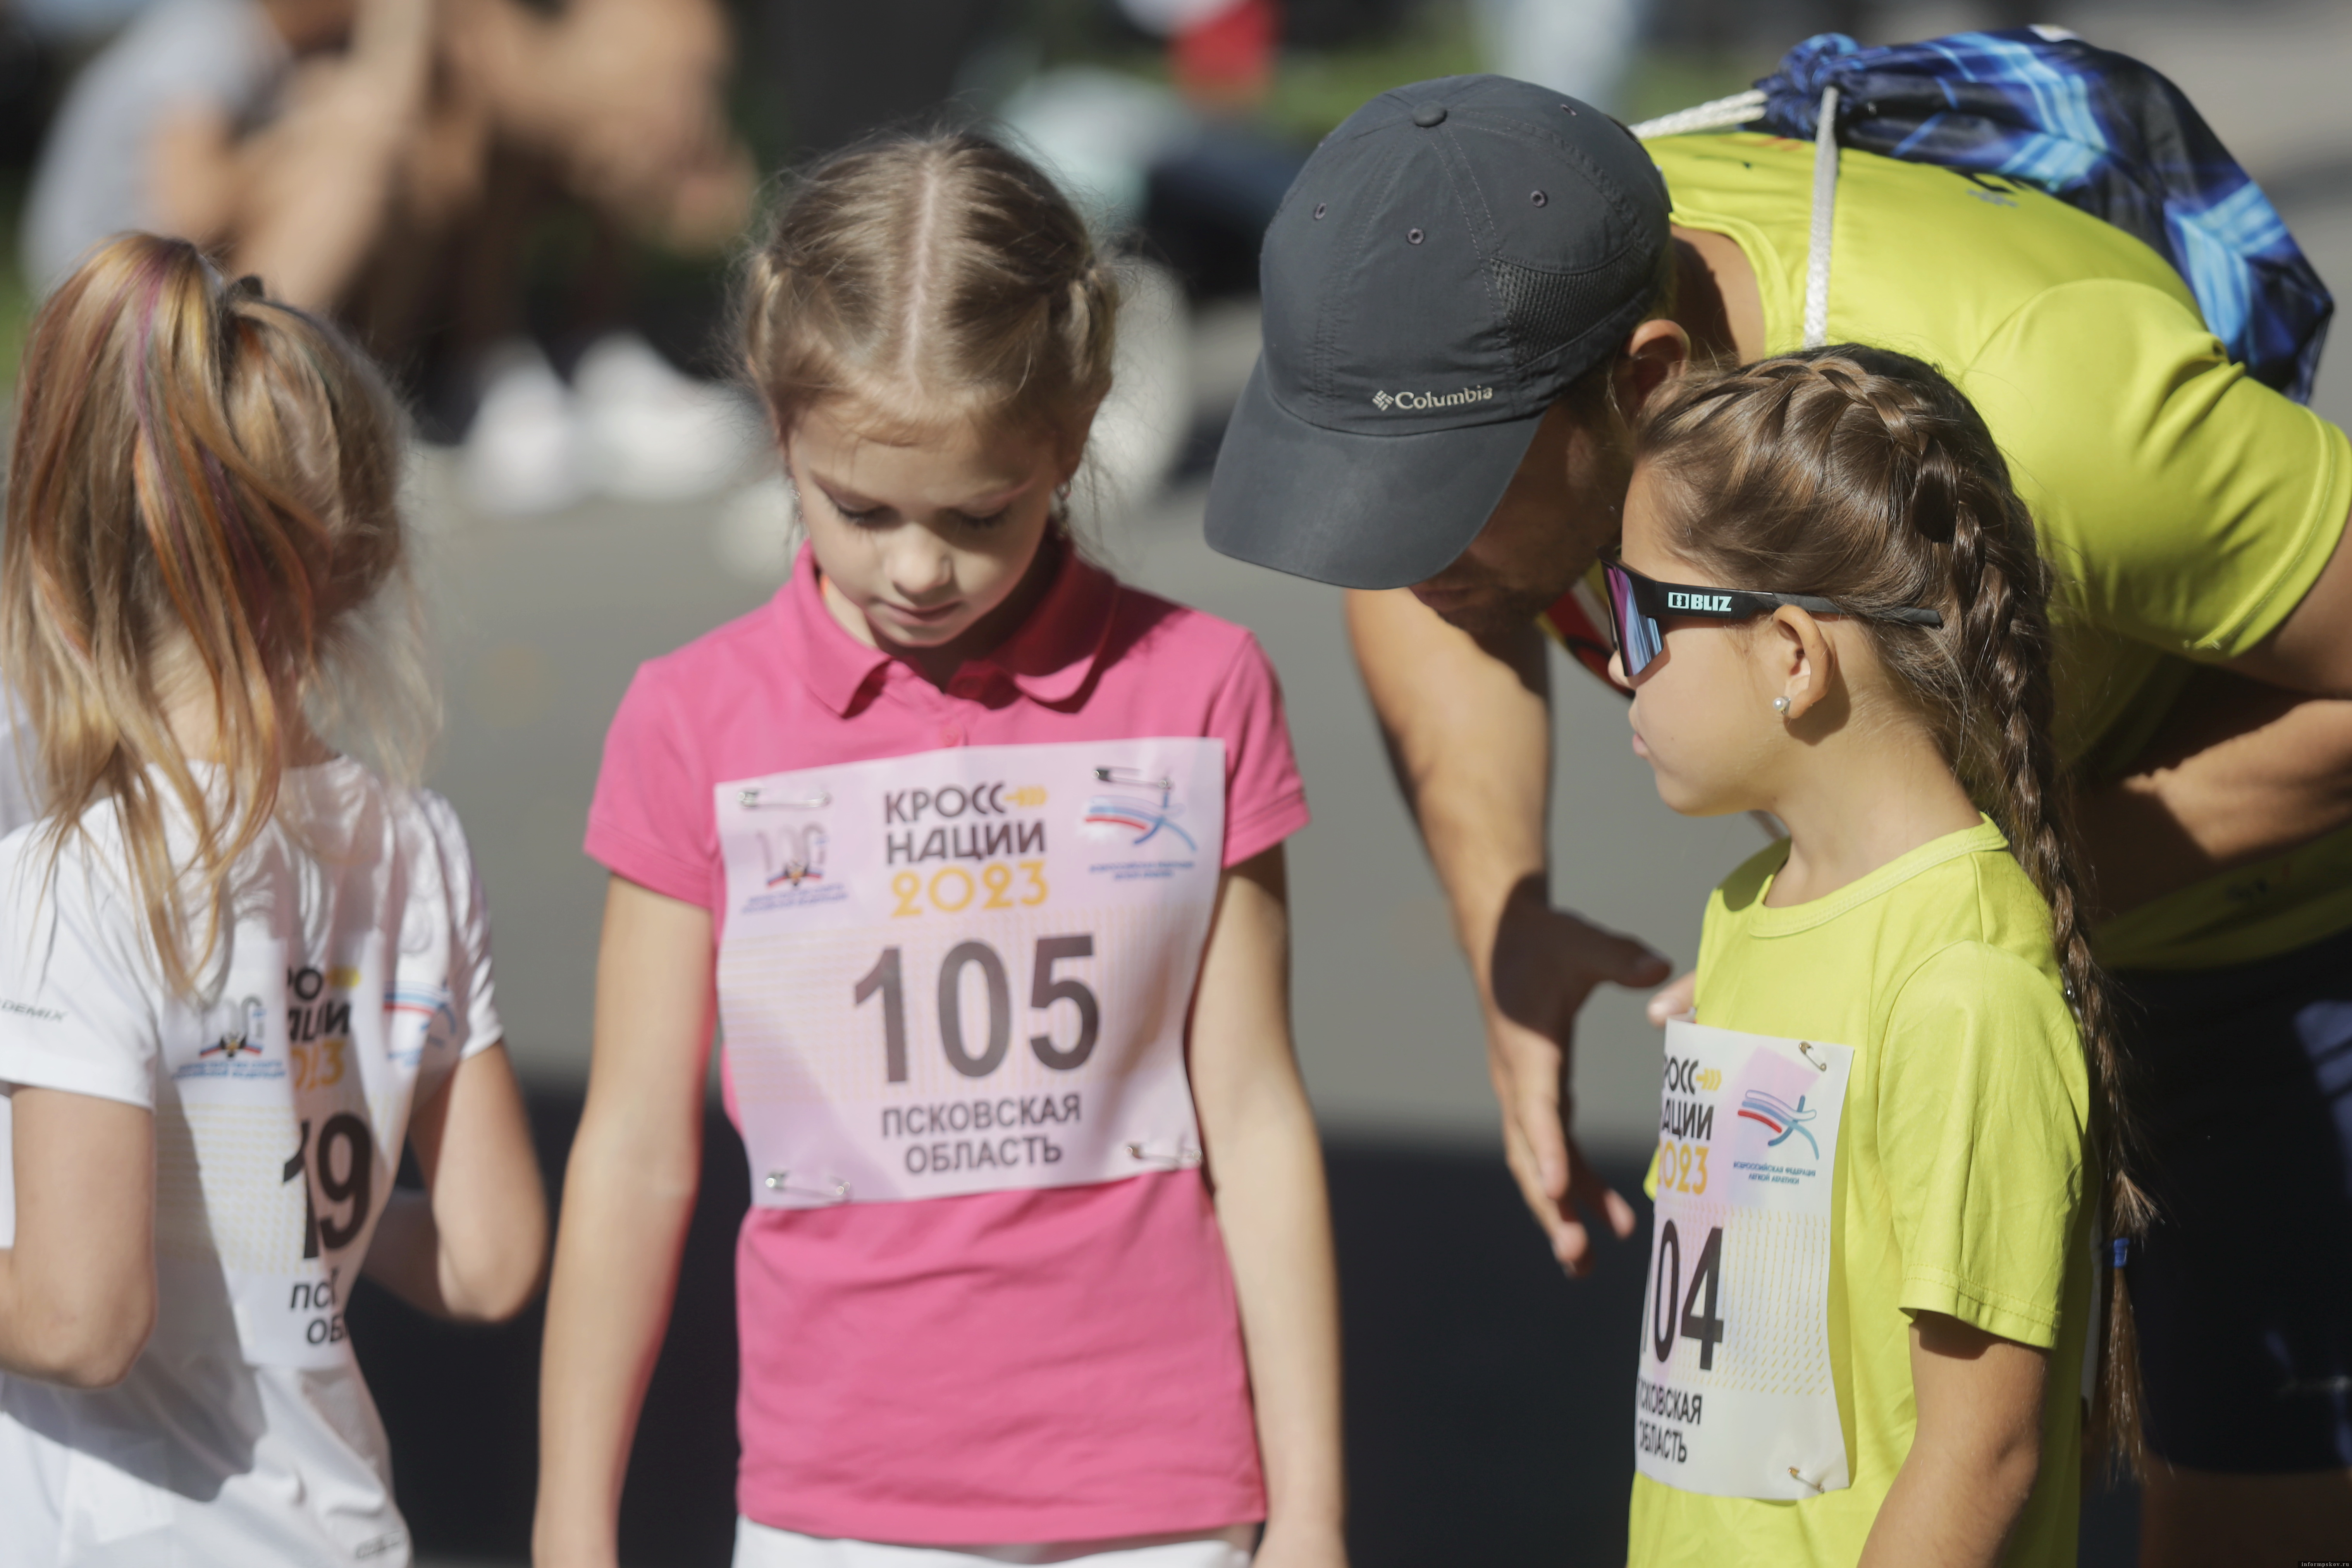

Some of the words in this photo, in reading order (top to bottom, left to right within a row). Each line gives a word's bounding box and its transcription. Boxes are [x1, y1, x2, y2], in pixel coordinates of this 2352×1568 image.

[1395, 385, 1493, 409] Columbia
[1691, 594, 1732, 612] BLIZ
[885, 780, 1007, 824] КРОСС
[886, 819, 1046, 866] НАЦИИ
[891, 859, 1049, 918] 2023
[855, 934, 1100, 1083] 105
[882, 1092, 1082, 1138] ПСКОВСКАЯ
[905, 1134, 1063, 1174] ОБЛАСТЬ
[1658, 1140, 1710, 1195] 023
[1641, 1219, 1724, 1371] 04
